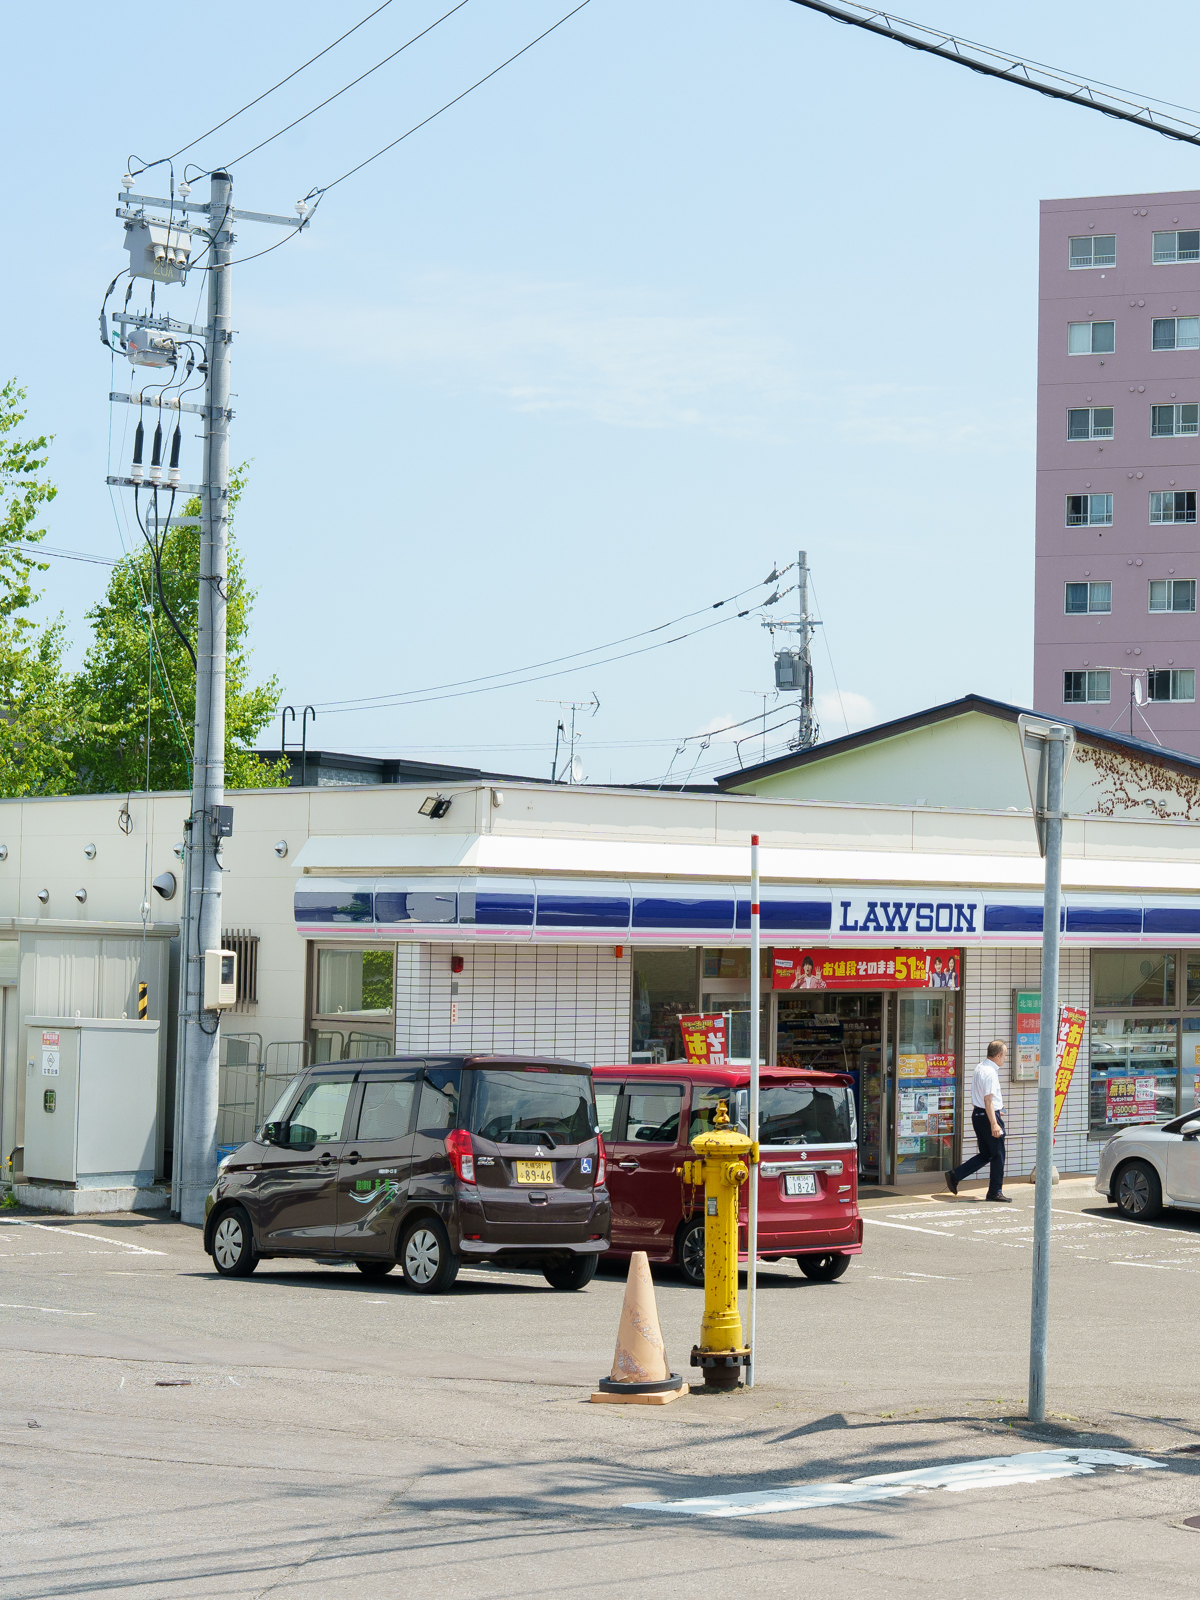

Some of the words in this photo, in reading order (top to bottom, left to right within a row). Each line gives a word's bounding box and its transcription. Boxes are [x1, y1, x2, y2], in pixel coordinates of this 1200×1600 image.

[839, 900, 977, 932] LAWSON
[1020, 999, 1041, 1008] 北海道
[525, 1170, 552, 1181] 89-46
[793, 1182, 815, 1193] 18-24
